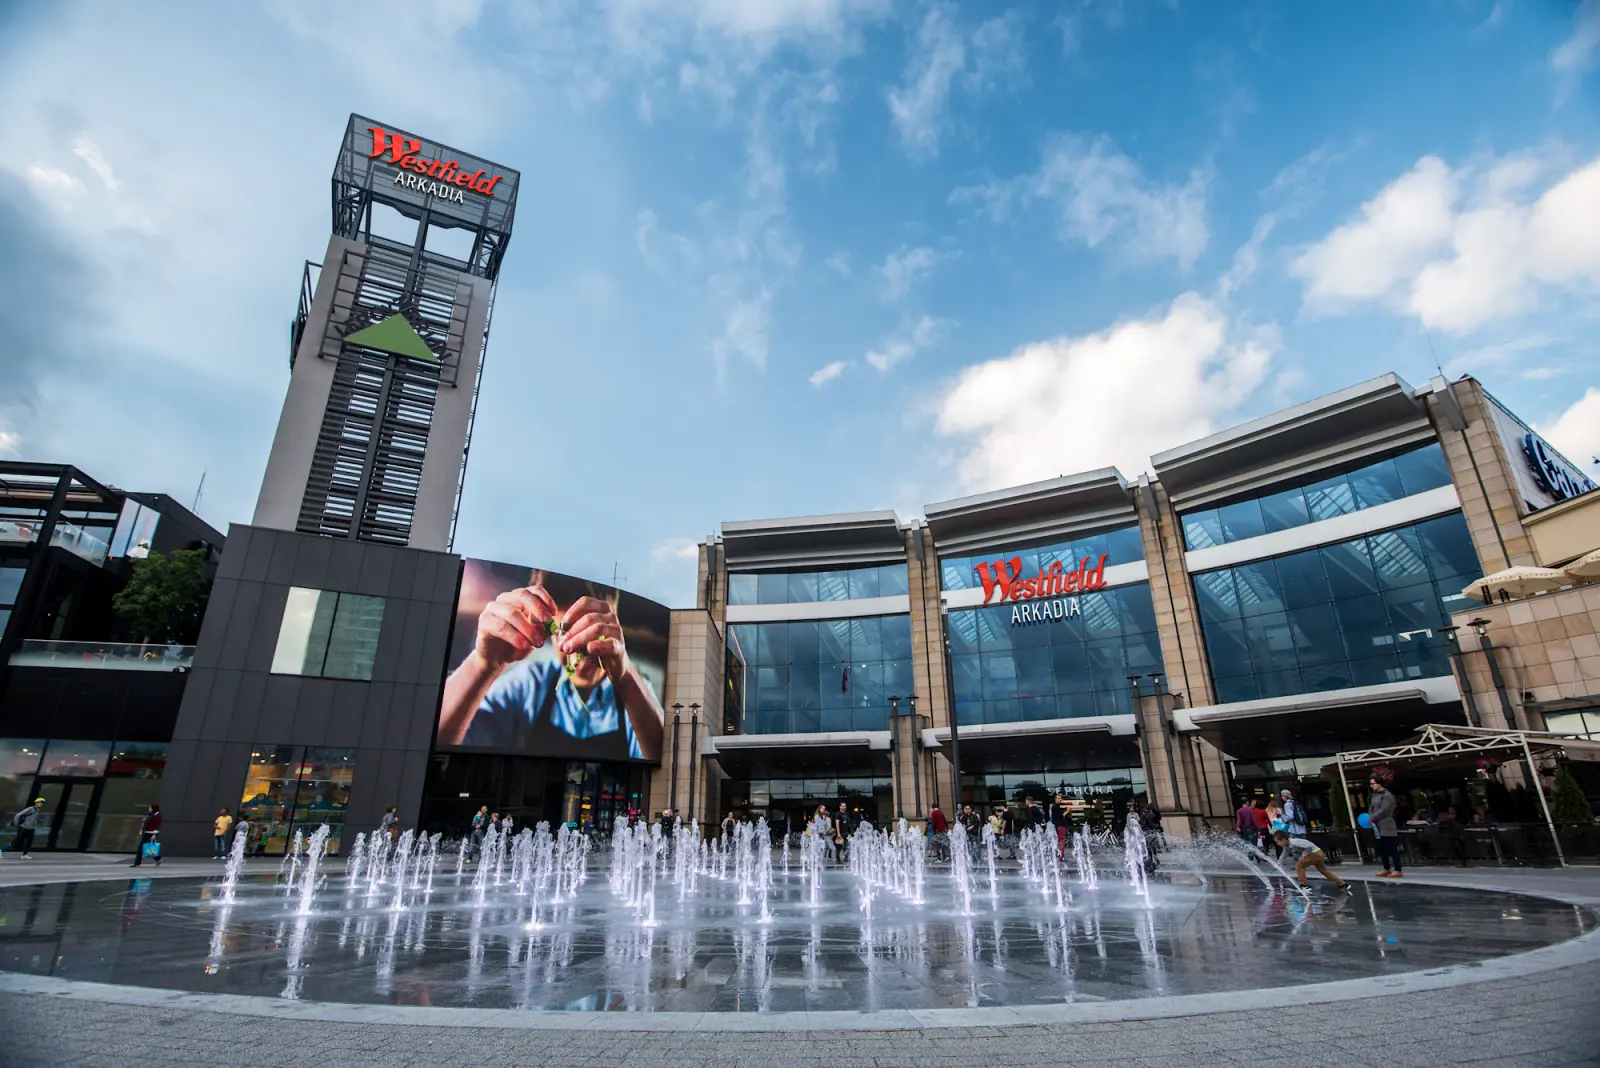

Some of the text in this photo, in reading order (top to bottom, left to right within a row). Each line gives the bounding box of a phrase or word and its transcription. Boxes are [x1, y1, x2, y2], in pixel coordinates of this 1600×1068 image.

[367, 127, 503, 196] Westfield
[394, 171, 464, 204] ARKADIA
[974, 553, 1109, 605] Westfield
[1011, 597, 1081, 625] ARKADIA
[1046, 784, 1113, 796] SEPHORA
